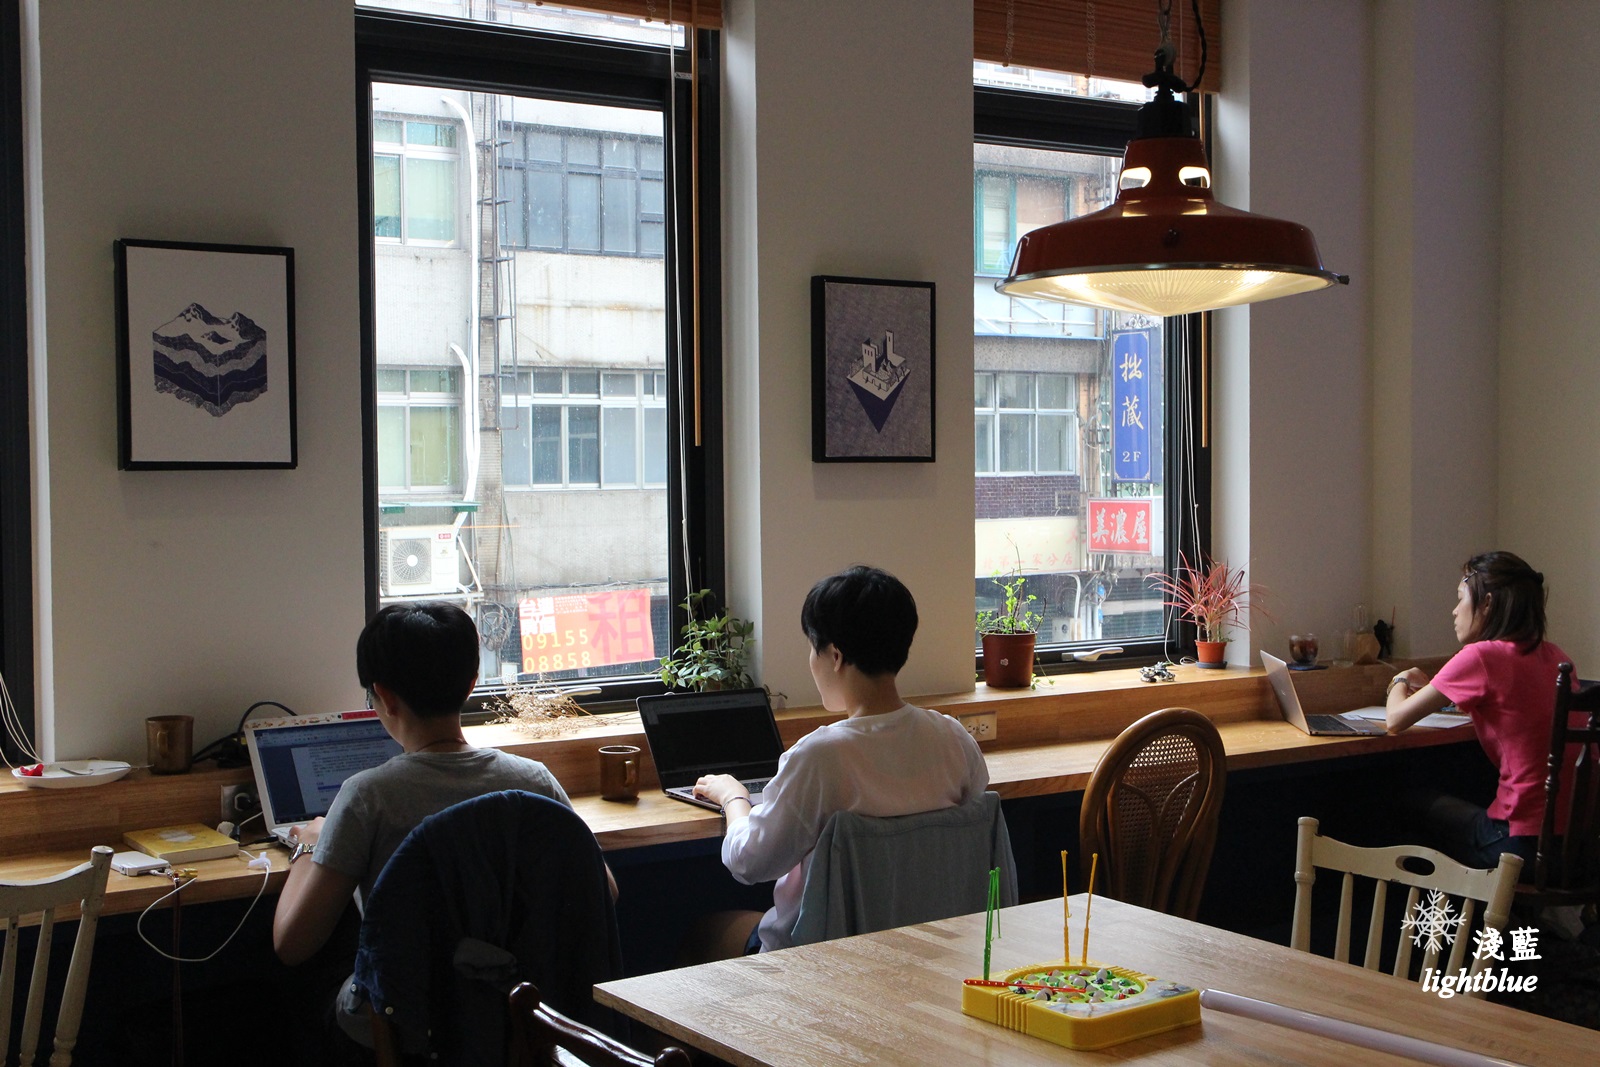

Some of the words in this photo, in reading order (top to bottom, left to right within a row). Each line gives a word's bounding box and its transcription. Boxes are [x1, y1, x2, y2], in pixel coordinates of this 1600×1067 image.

[1122, 451, 1142, 463] 2F
[1092, 507, 1149, 545] 美濃屋
[522, 628, 589, 651] 09155
[587, 591, 653, 664] 租
[524, 650, 592, 674] 08858
